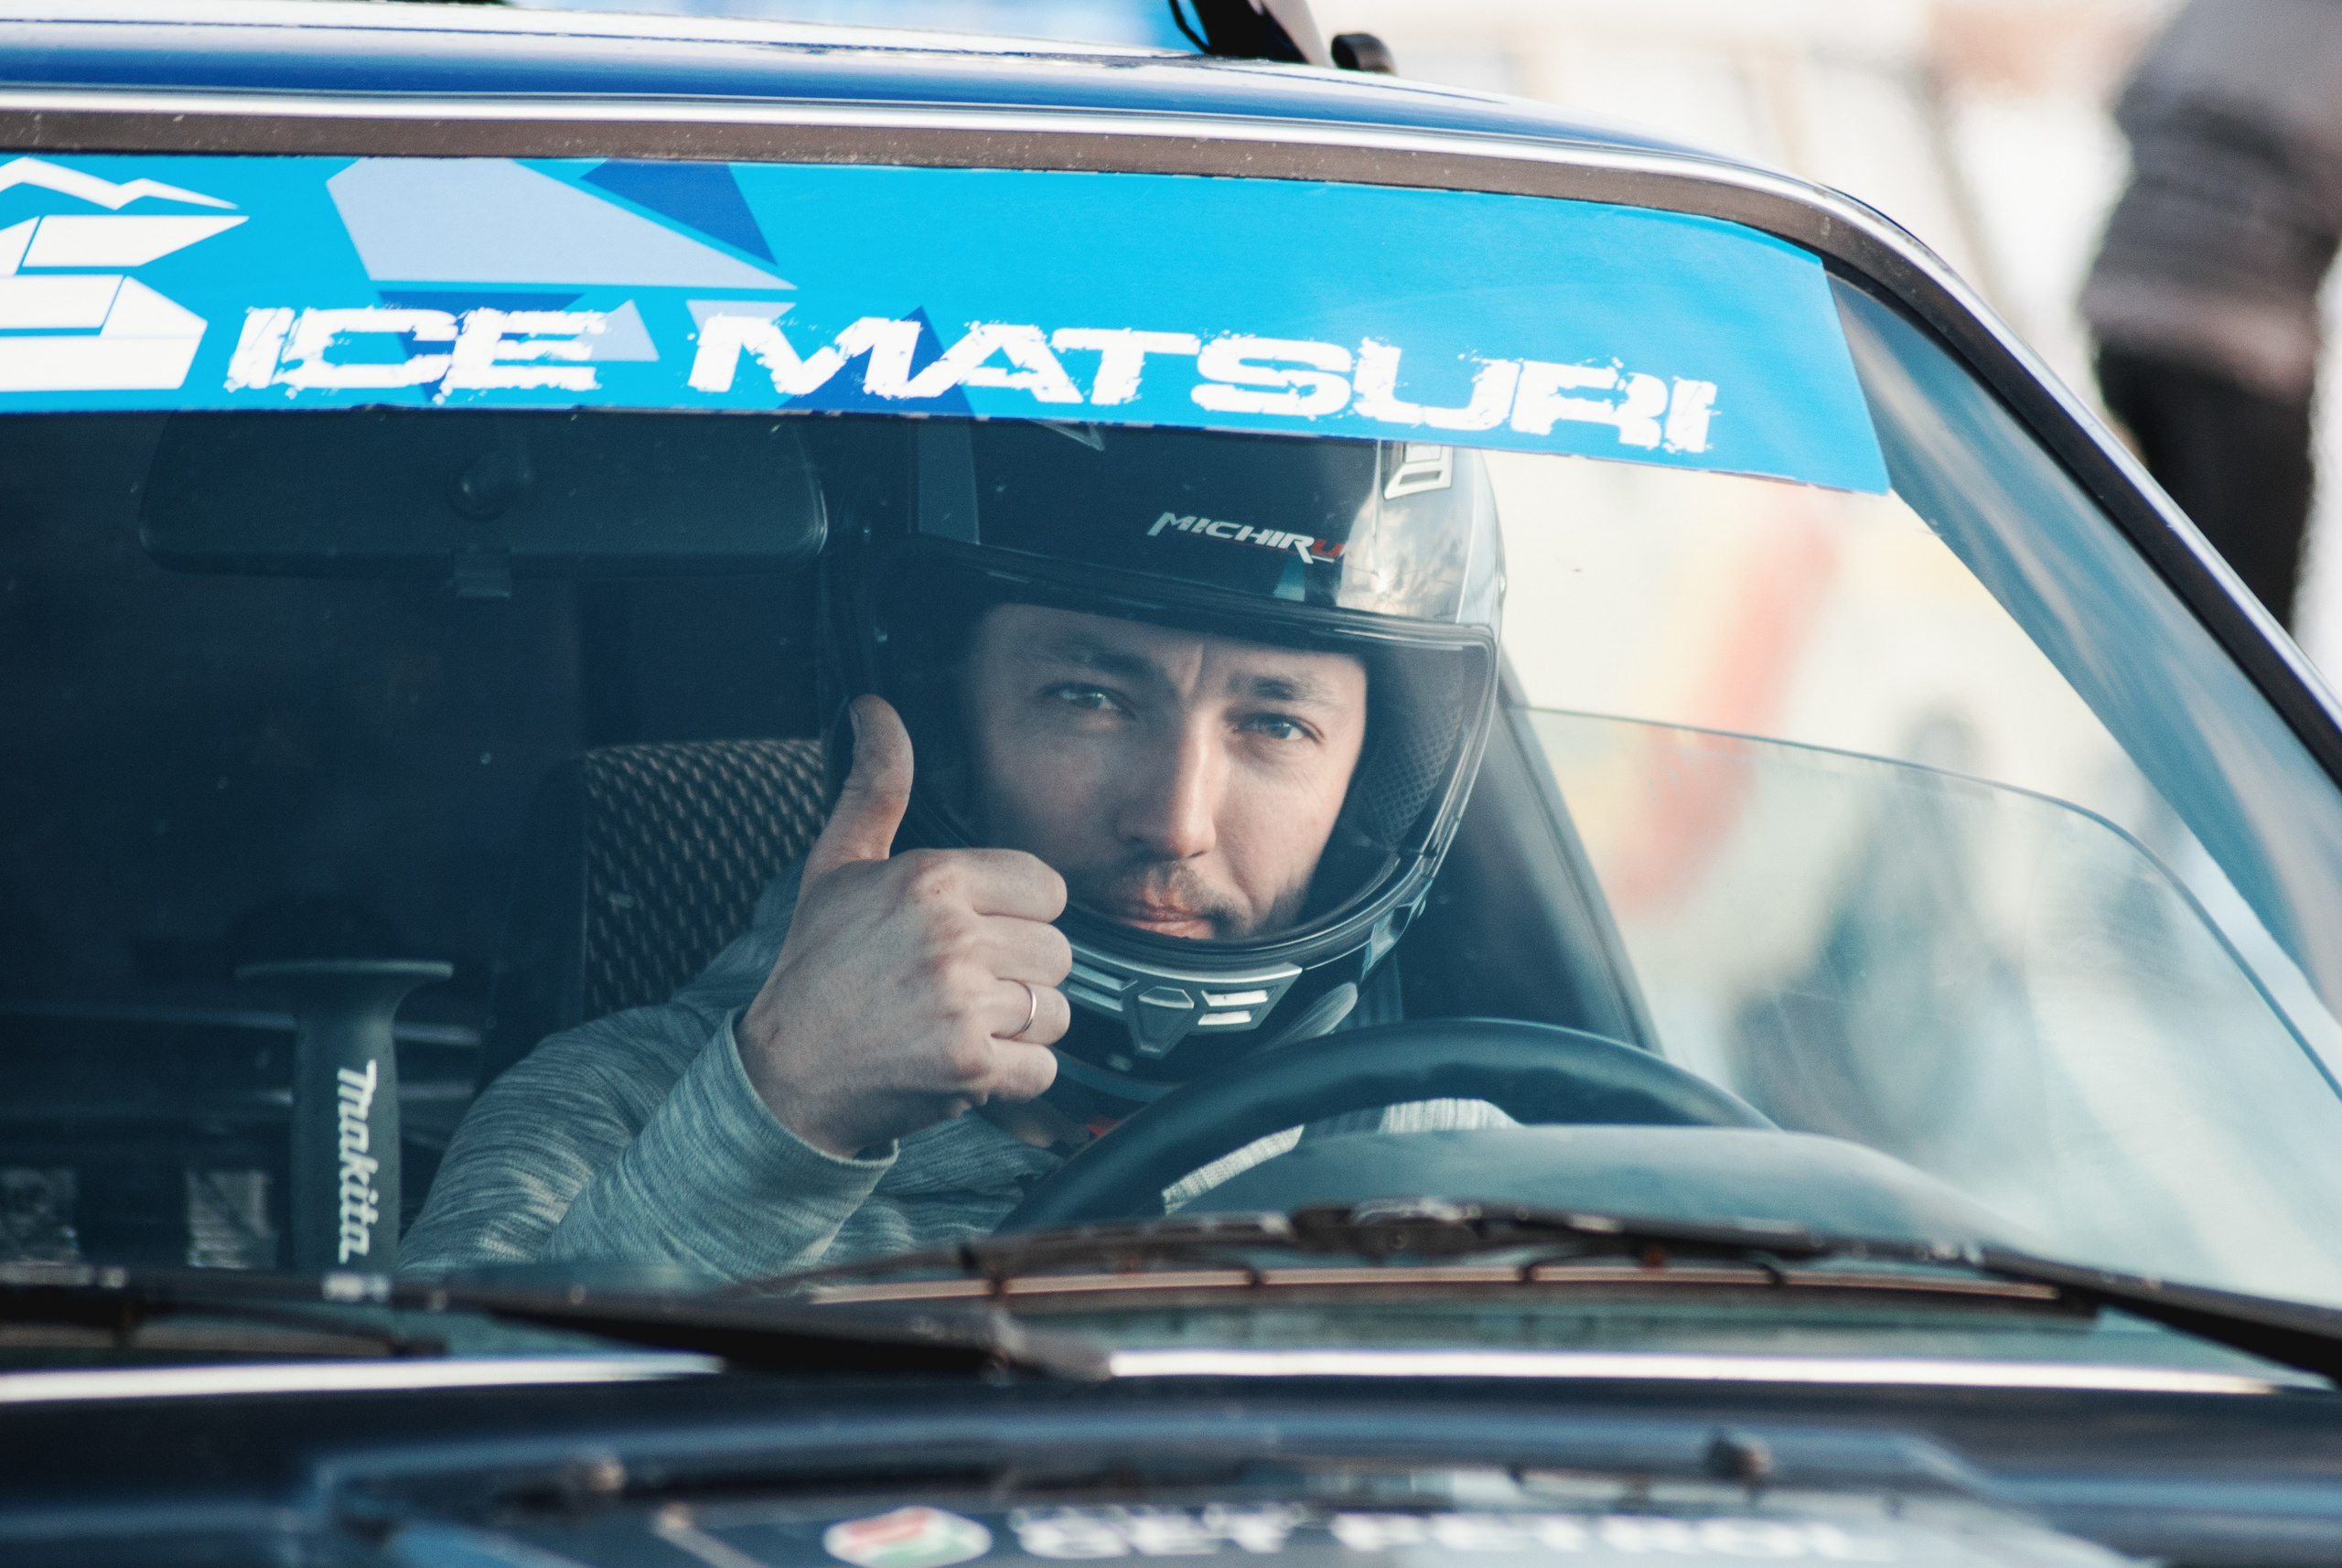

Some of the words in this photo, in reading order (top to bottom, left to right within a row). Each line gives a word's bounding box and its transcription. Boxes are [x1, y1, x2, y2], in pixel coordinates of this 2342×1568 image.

[223, 306, 611, 404] ICE
[686, 314, 1722, 455] MATSURI
[1146, 511, 1347, 564] MICHIRU
